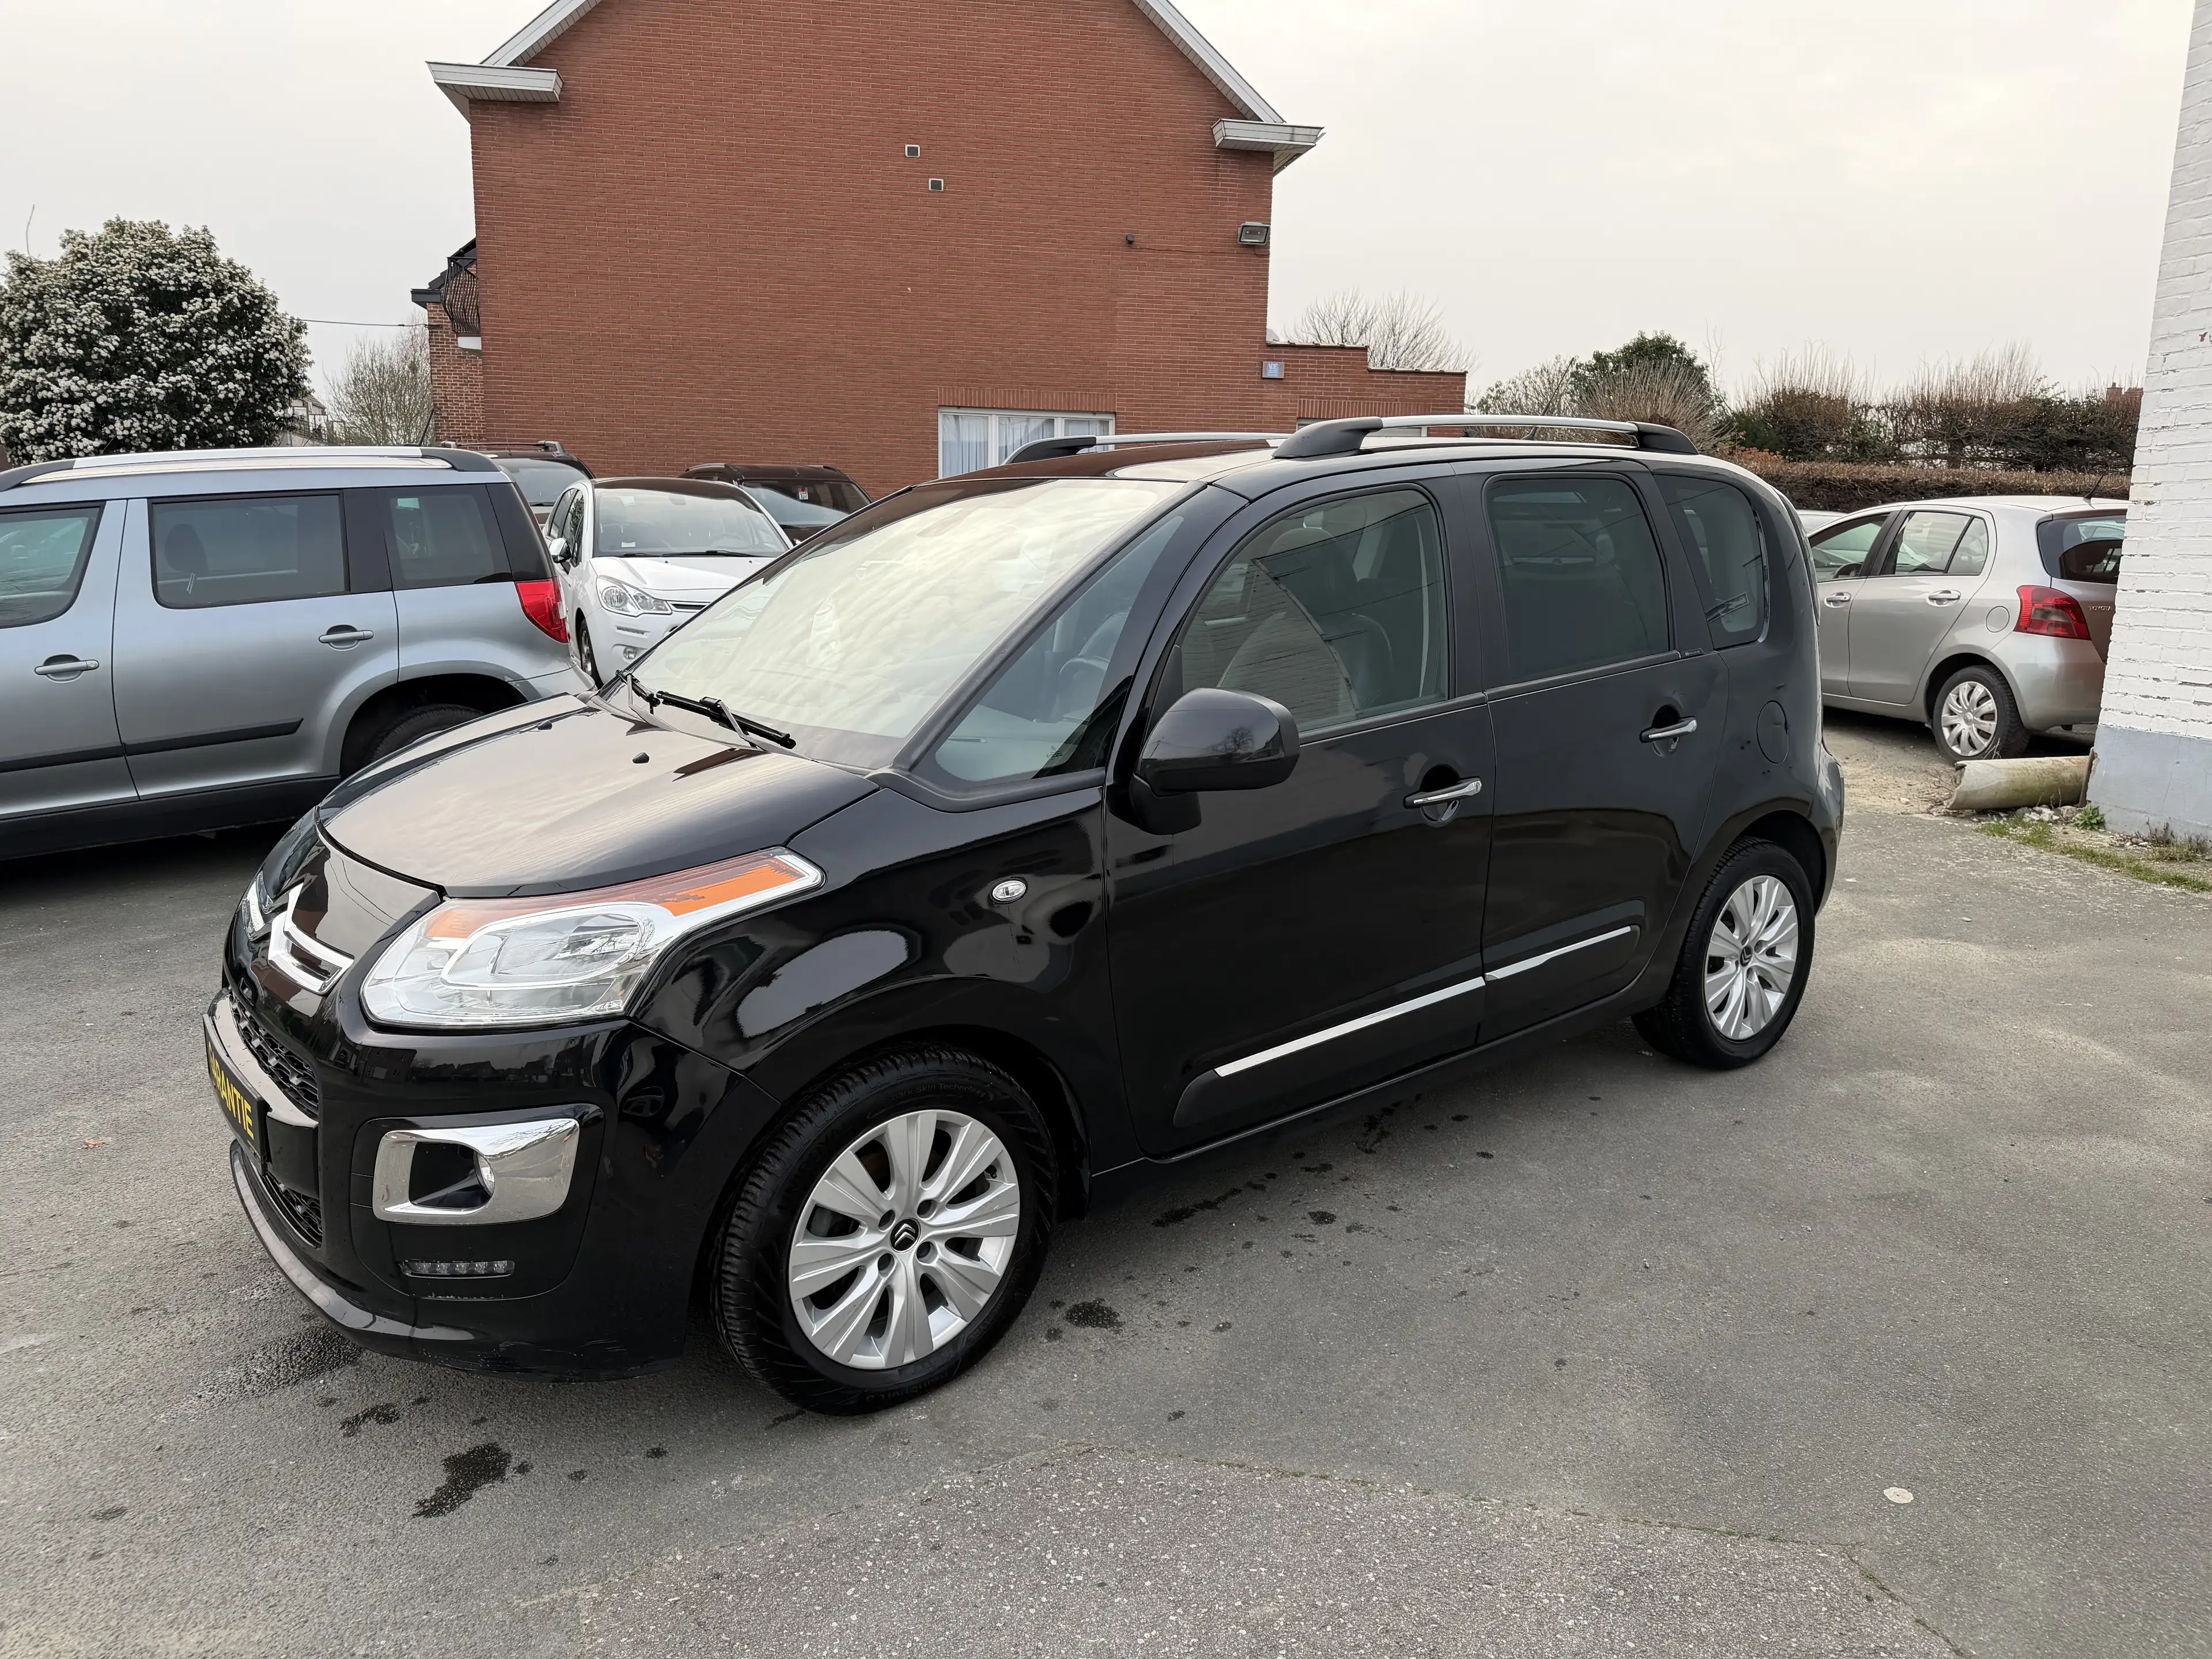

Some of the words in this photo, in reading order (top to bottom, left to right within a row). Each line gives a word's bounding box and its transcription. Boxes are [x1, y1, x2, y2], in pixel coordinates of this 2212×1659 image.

[209, 1040, 254, 1141] GARANTIE
[915, 1084, 936, 1093] Skin
[938, 1083, 986, 1097] Technology
